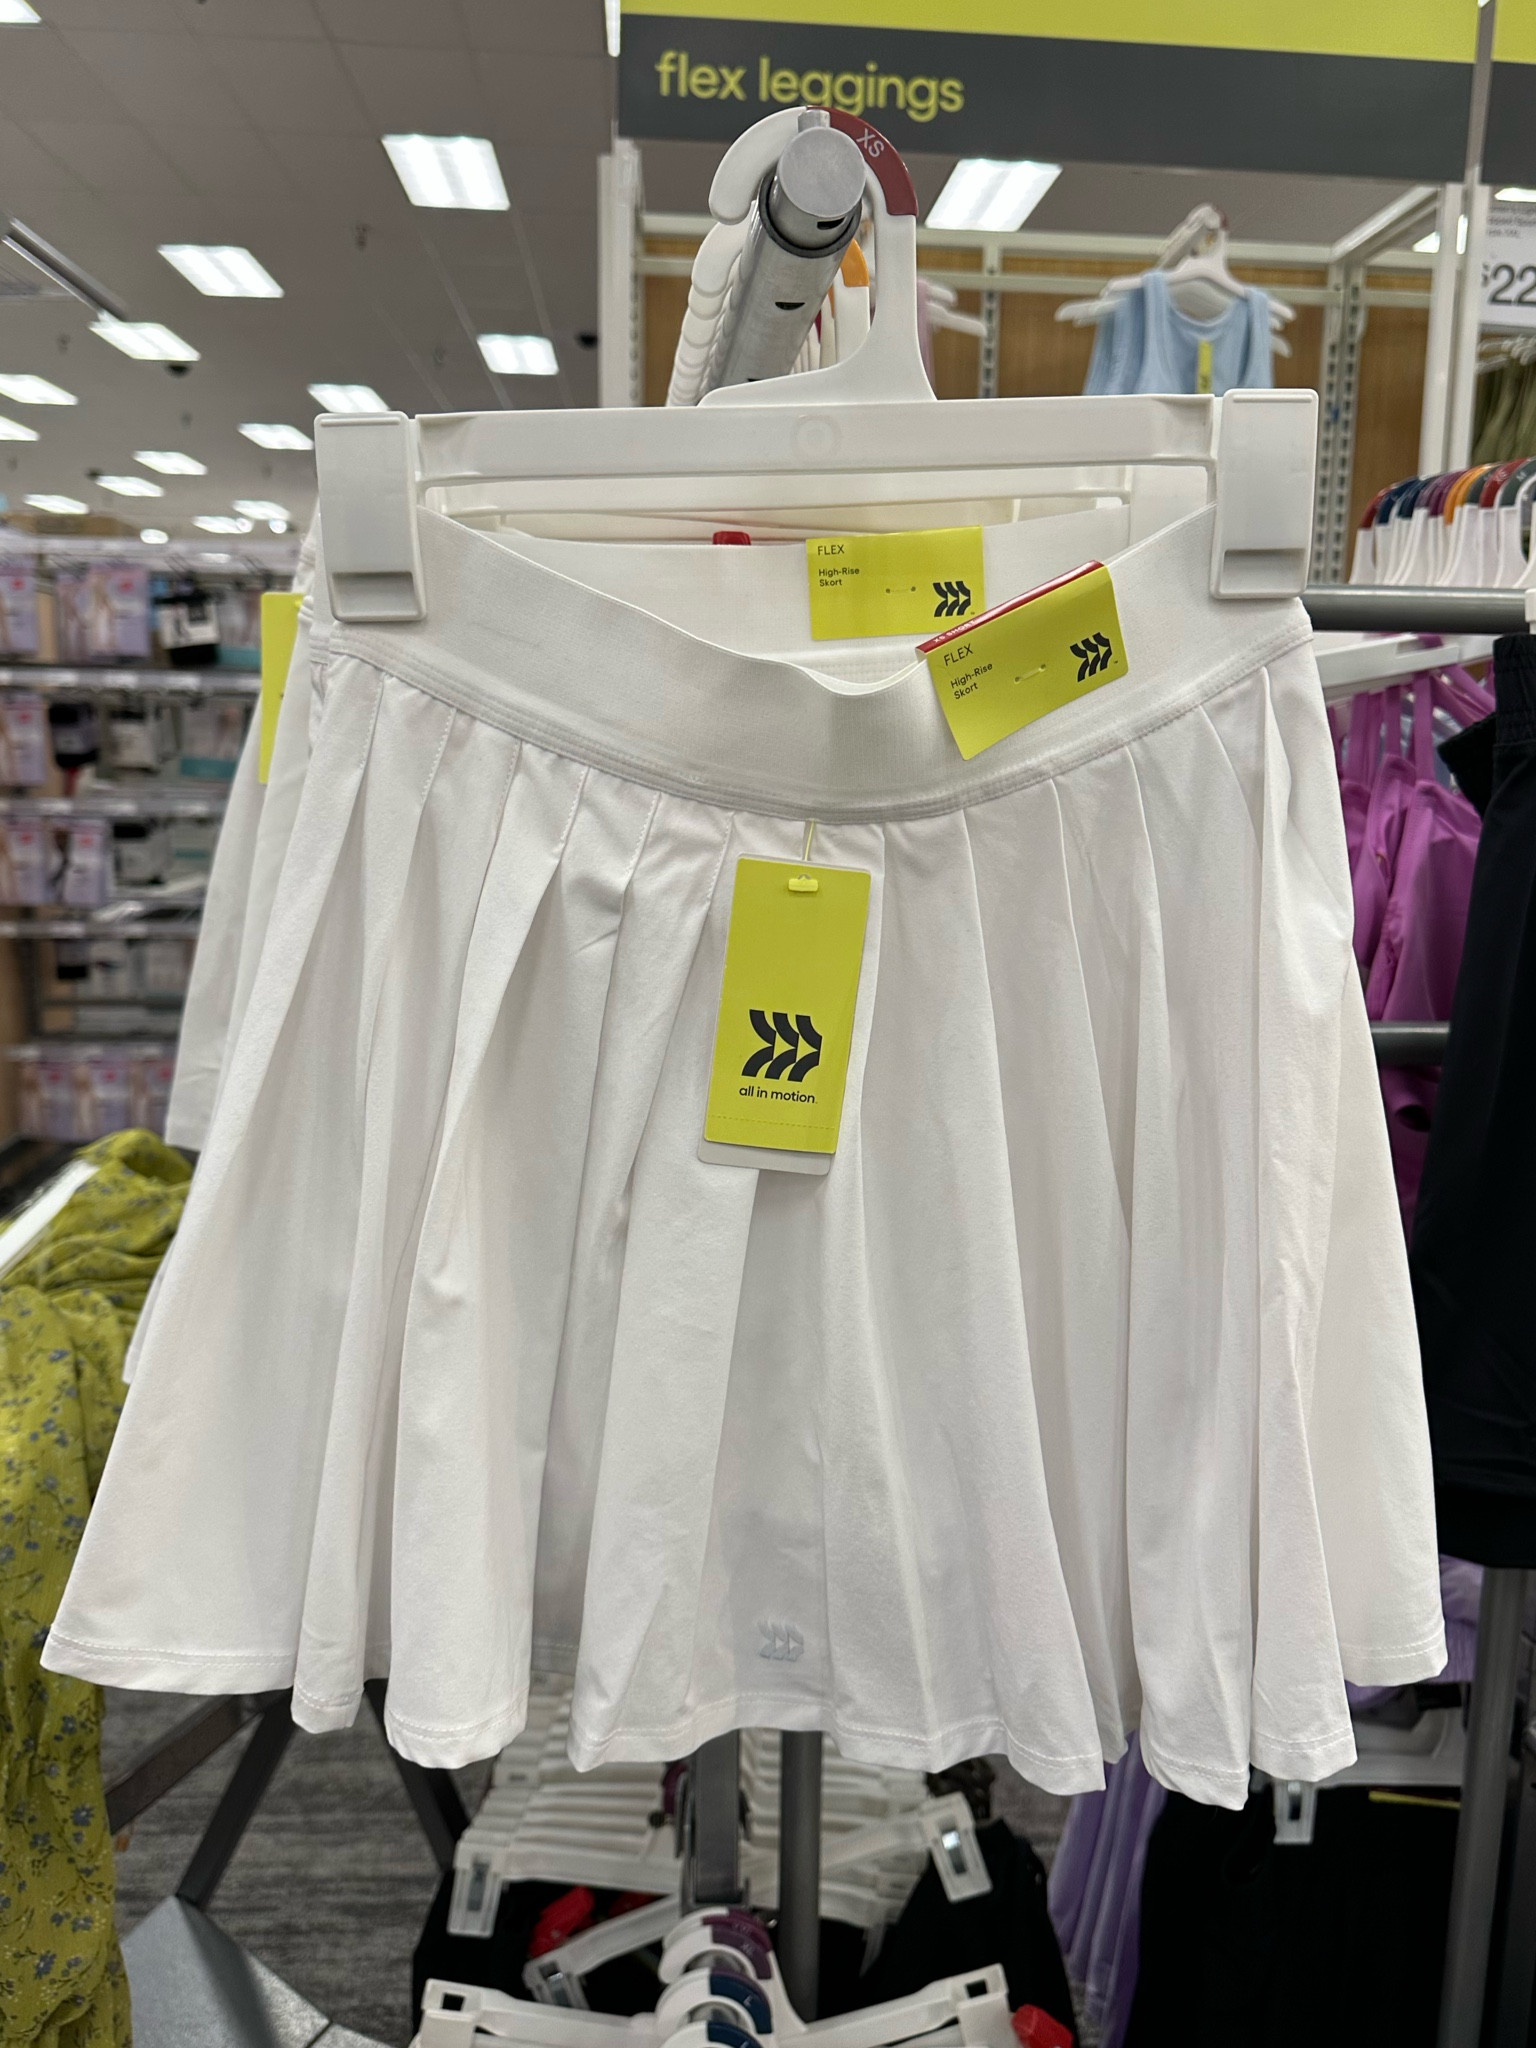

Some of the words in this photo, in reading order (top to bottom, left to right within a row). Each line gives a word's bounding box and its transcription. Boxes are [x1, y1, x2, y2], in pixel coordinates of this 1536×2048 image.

[654, 50, 747, 101] flex
[759, 55, 966, 122] leggings
[856, 128, 885, 158] XS
[817, 544, 845, 556] FLEX
[818, 567, 860, 578] High-Rise
[819, 579, 843, 587] Skort
[943, 643, 974, 667] FLEX
[950, 663, 993, 689] High-Rise
[953, 682, 978, 700] Skort
[739, 1086, 754, 1097] all
[756, 1087, 768, 1099] in
